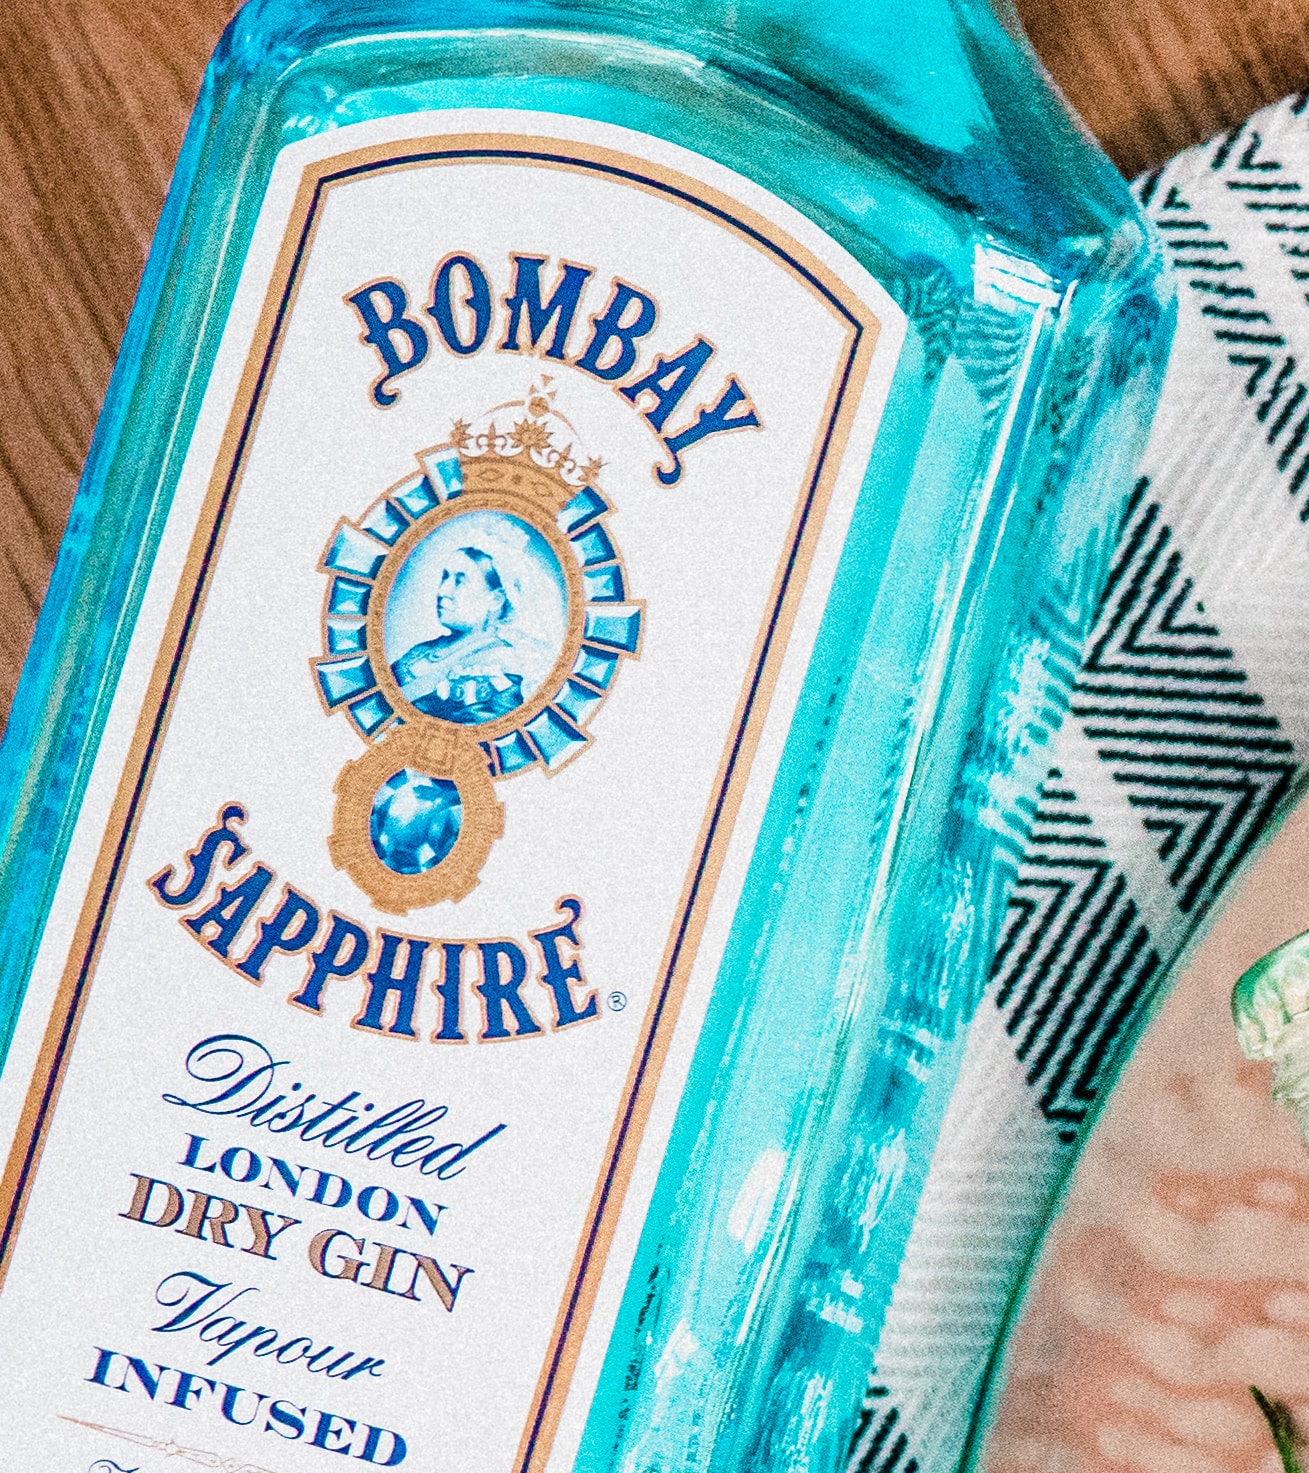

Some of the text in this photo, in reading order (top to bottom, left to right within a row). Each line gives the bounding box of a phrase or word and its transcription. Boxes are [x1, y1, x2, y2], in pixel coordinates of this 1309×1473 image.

[342, 251, 761, 489] BOMBAY
[148, 802, 600, 1045] SAPPHIRE
[162, 1033, 508, 1181] Distilled
[118, 1173, 476, 1313] DRY GIN
[179, 1132, 449, 1237] LONDON
[151, 1271, 387, 1382] Vapour
[84, 1346, 409, 1468] INFUSED
